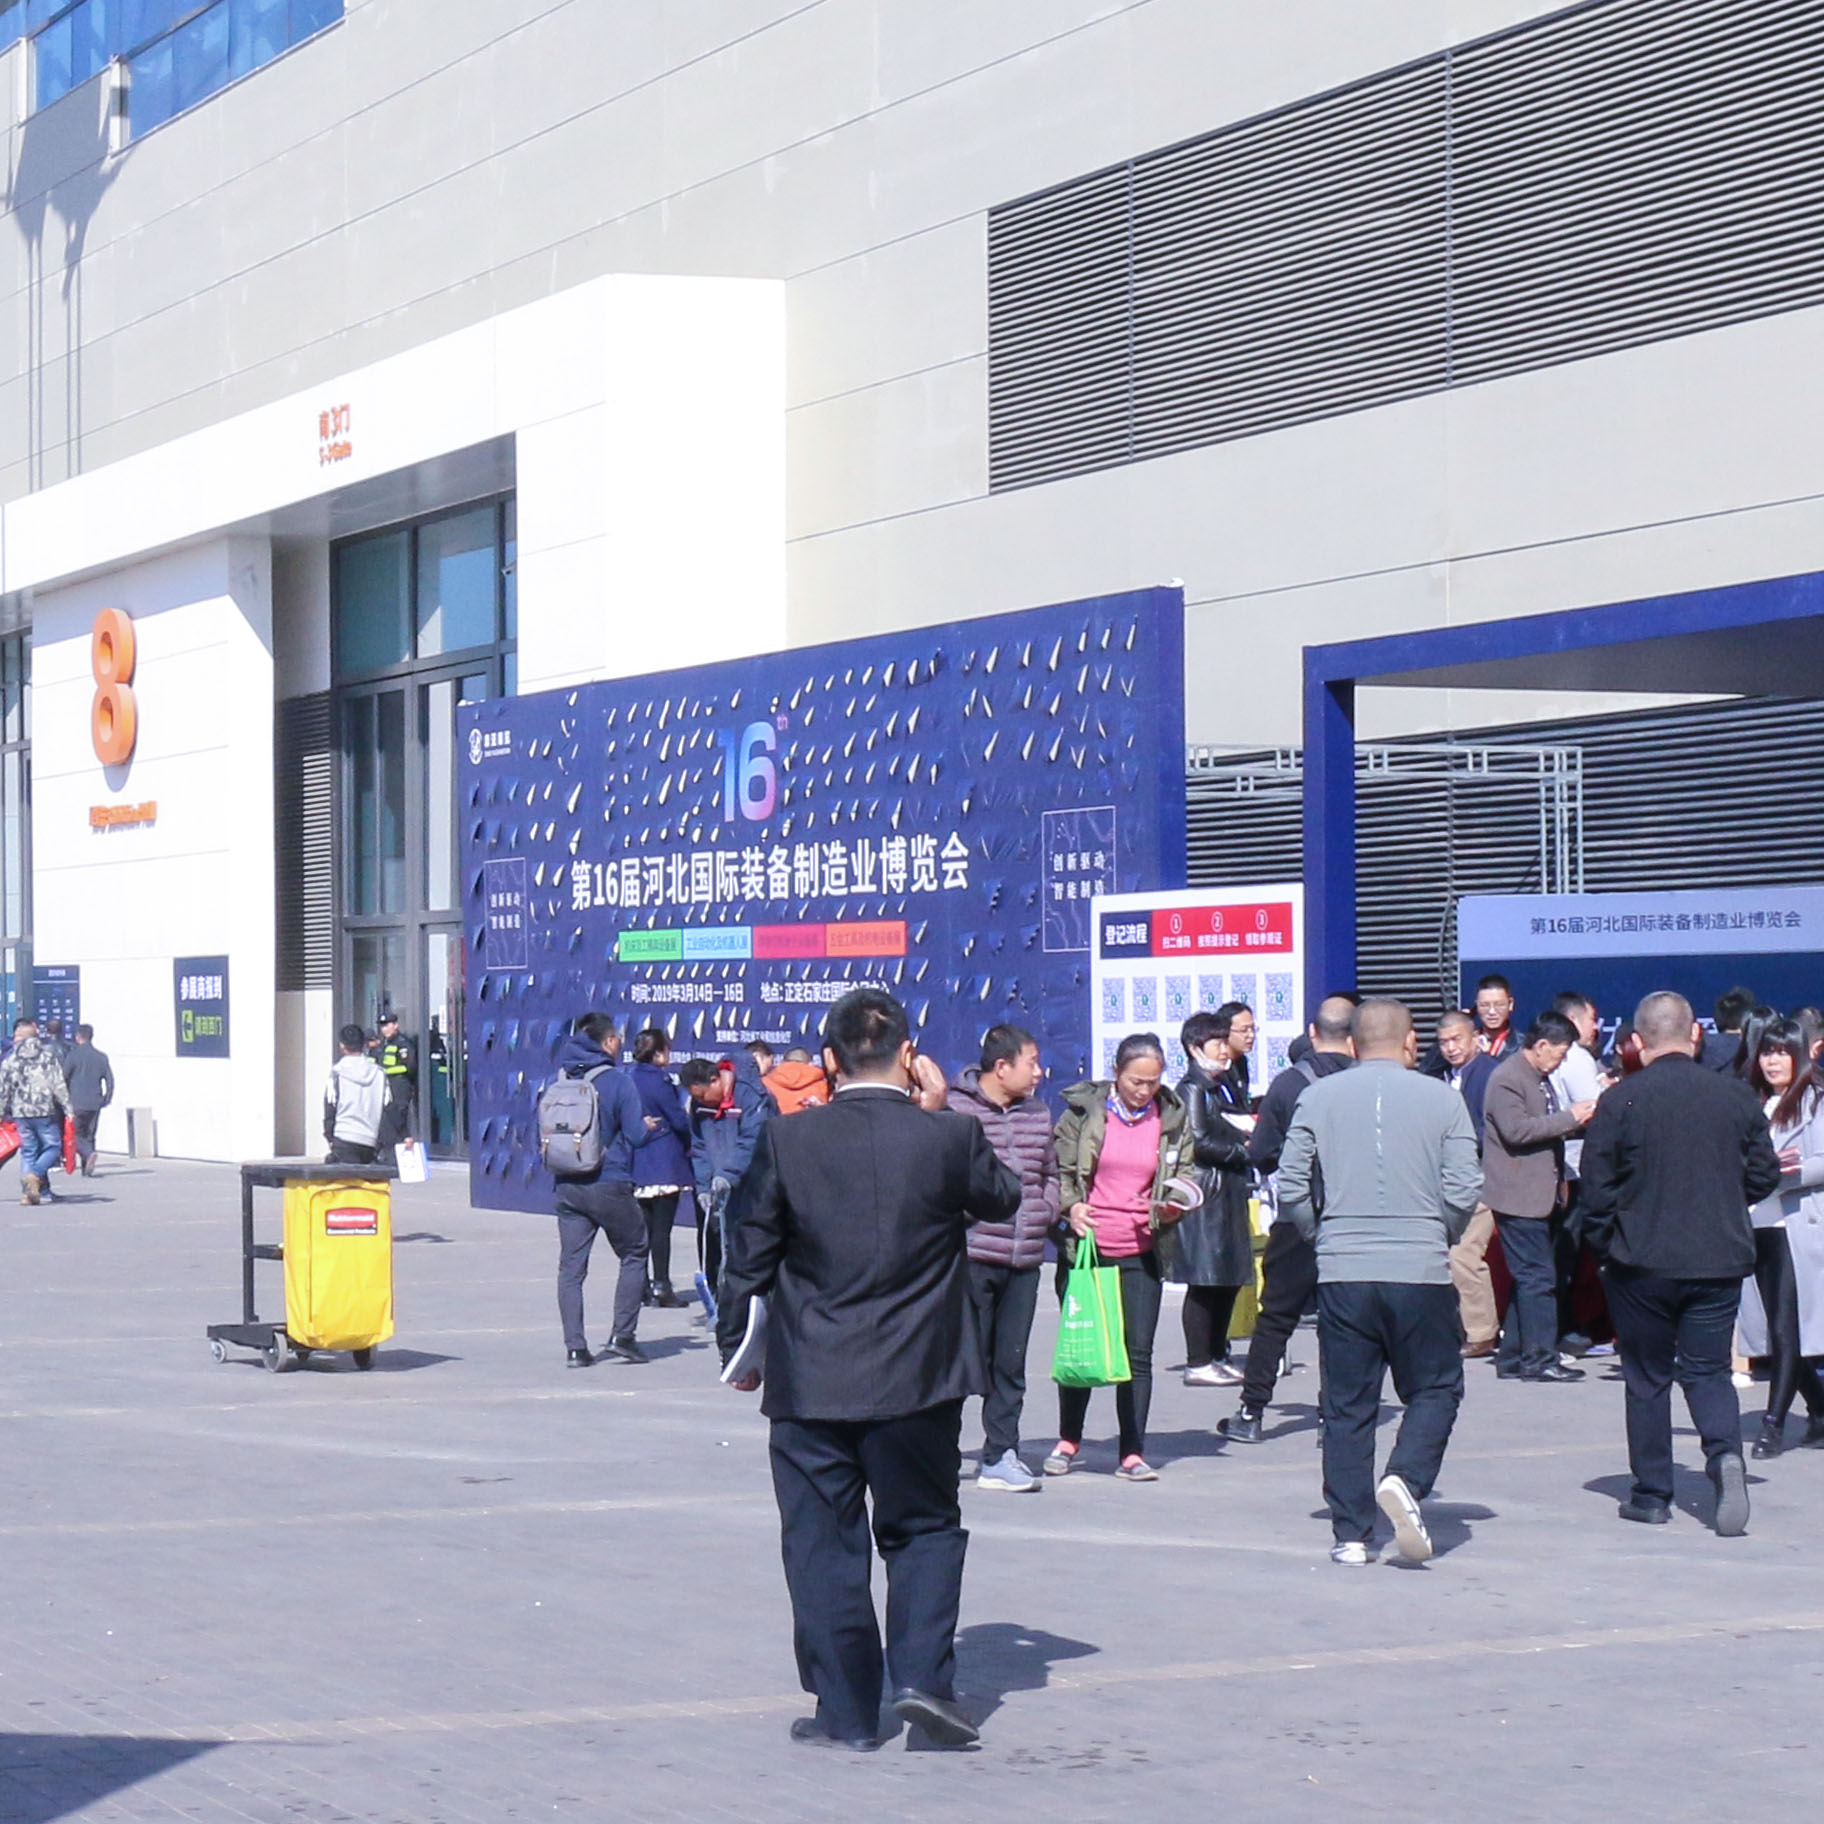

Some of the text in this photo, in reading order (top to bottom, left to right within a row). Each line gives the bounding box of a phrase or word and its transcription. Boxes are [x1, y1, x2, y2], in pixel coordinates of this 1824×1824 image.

[91, 607, 137, 766] 8
[717, 721, 777, 823] 16
[571, 831, 970, 911] 第16届河北国际装备制造业博览会
[1104, 923, 1148, 946] 登记流程
[1530, 911, 1802, 936] 第16届河北国际装备制造业博览会
